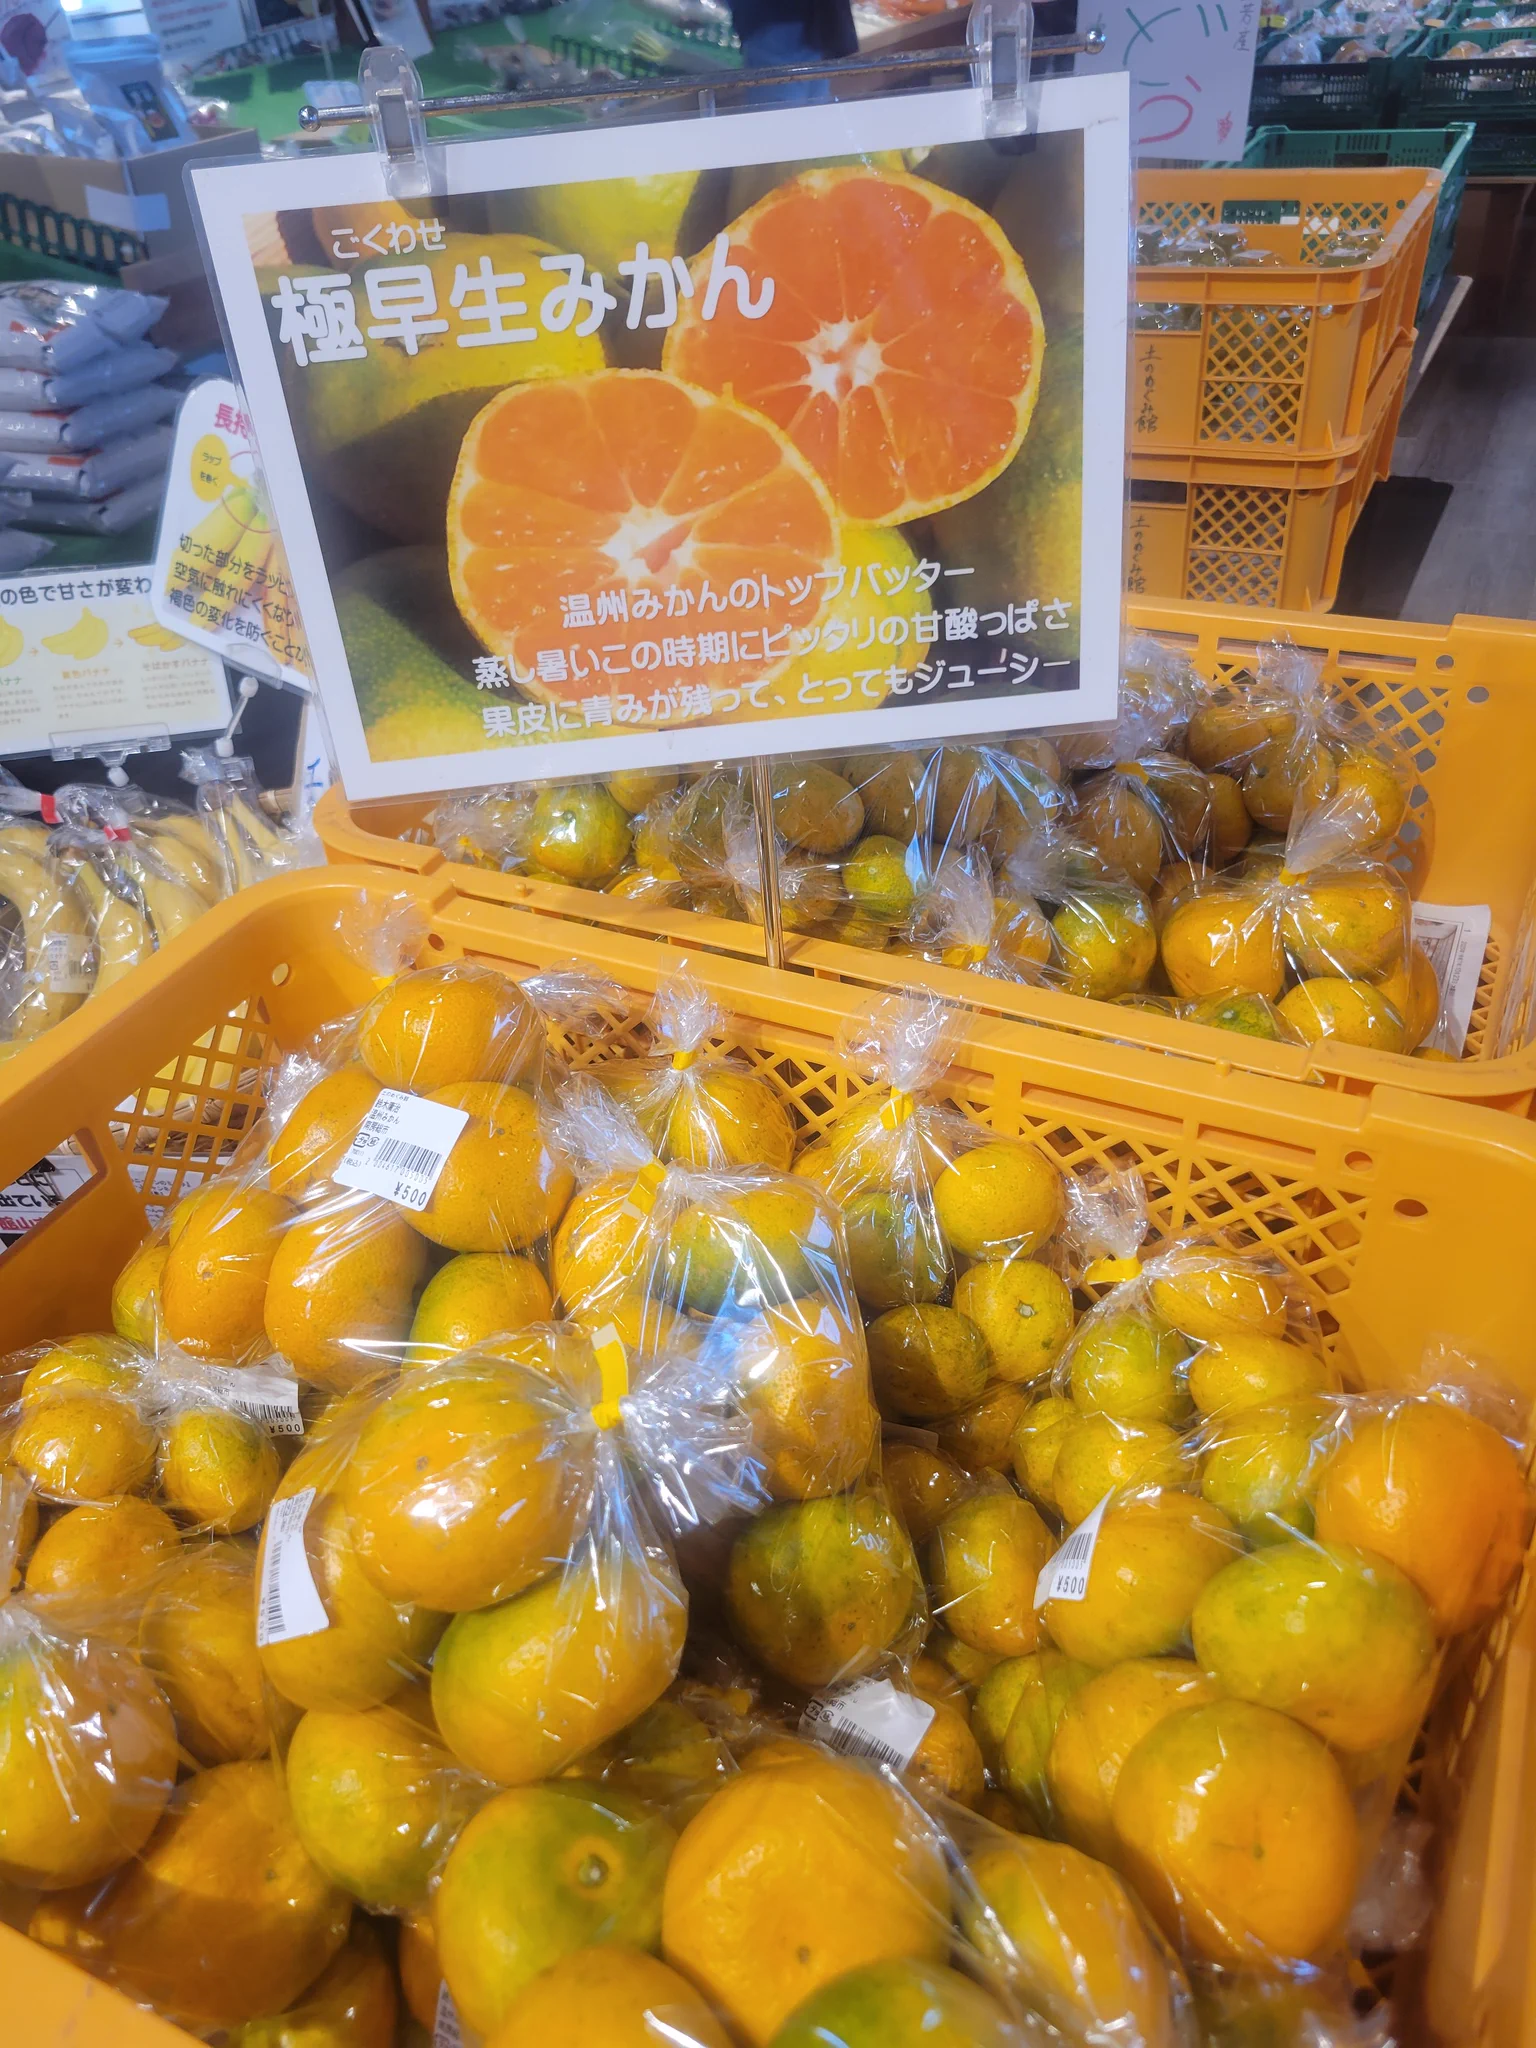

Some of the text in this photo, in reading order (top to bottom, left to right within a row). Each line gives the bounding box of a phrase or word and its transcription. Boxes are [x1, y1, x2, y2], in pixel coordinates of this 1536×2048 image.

[331, 218, 446, 259] ごくわせ
[270, 233, 776, 367] 極早生みかん
[559, 557, 975, 629] 温州みかんのトップバッター
[471, 597, 1073, 690] 蒸し暑いこの時期にピッタリの甘酸っぱさ
[481, 650, 1071, 739] 果皮に青みが残って、とってもジューシー
[394, 1181, 427, 1207] ¥500
[269, 1423, 301, 1434] ¥500
[1056, 1575, 1085, 1594] ¥500
